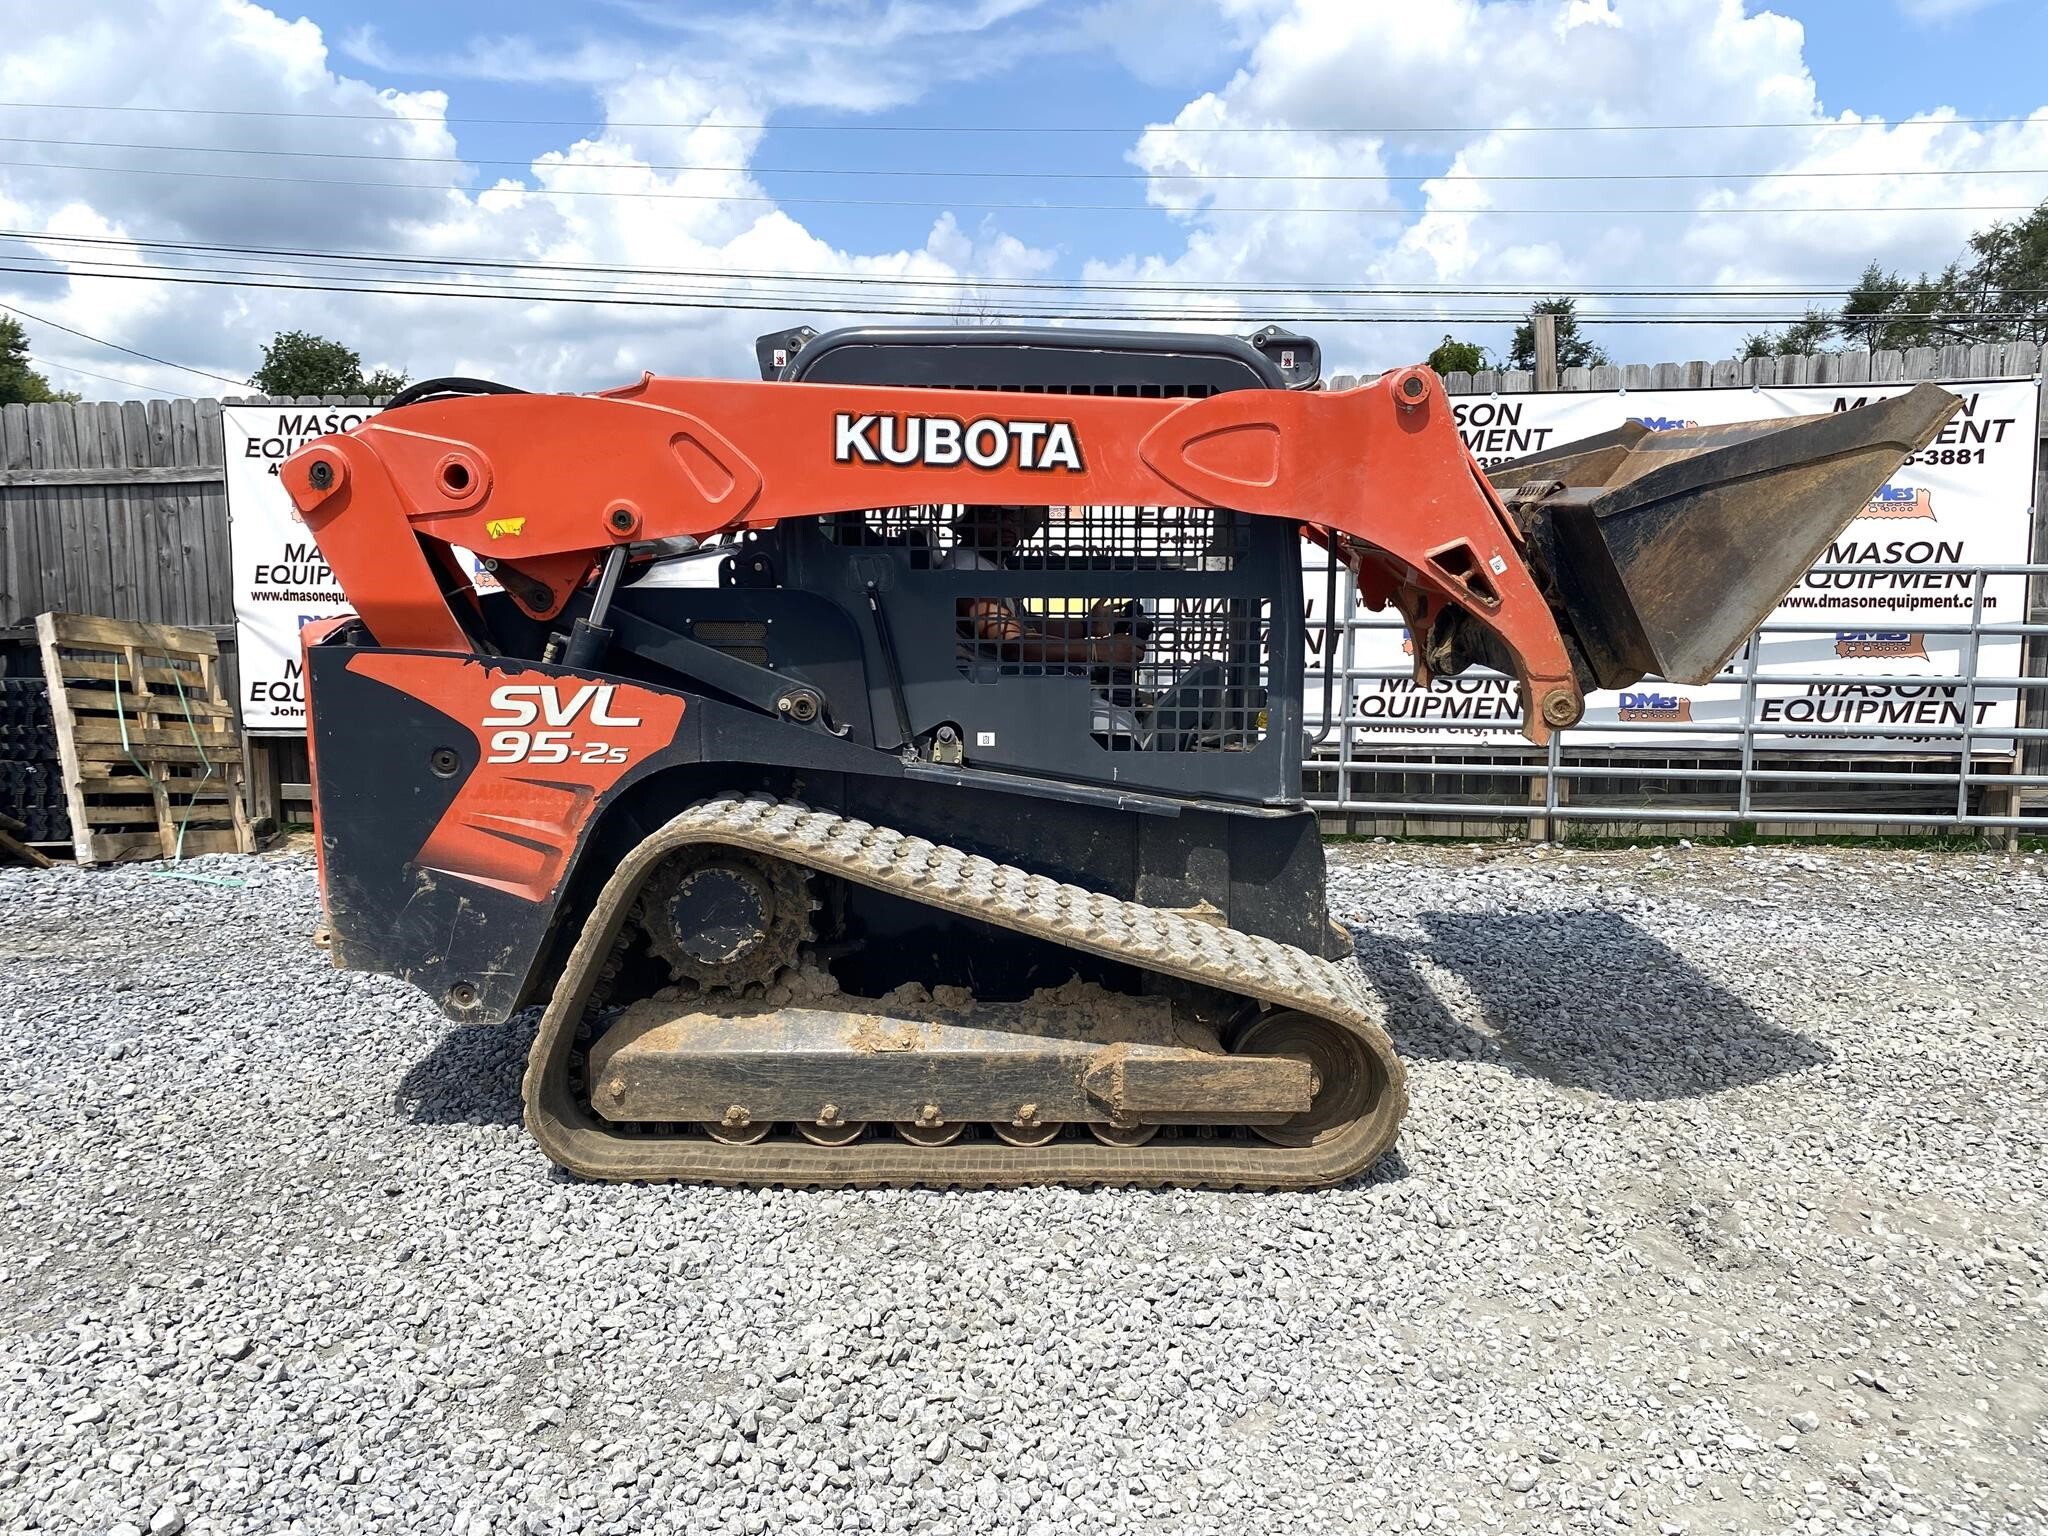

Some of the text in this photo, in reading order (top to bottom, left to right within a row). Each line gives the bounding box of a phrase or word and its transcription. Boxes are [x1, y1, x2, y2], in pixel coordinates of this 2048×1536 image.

[834, 413, 1082, 470] KUBOTA
[1825, 541, 1964, 564] MASON
[1779, 593, 1997, 612] www.dmasonequipment.cm
[482, 685, 642, 727] SVL
[1760, 699, 1997, 724] EQUIPMENT
